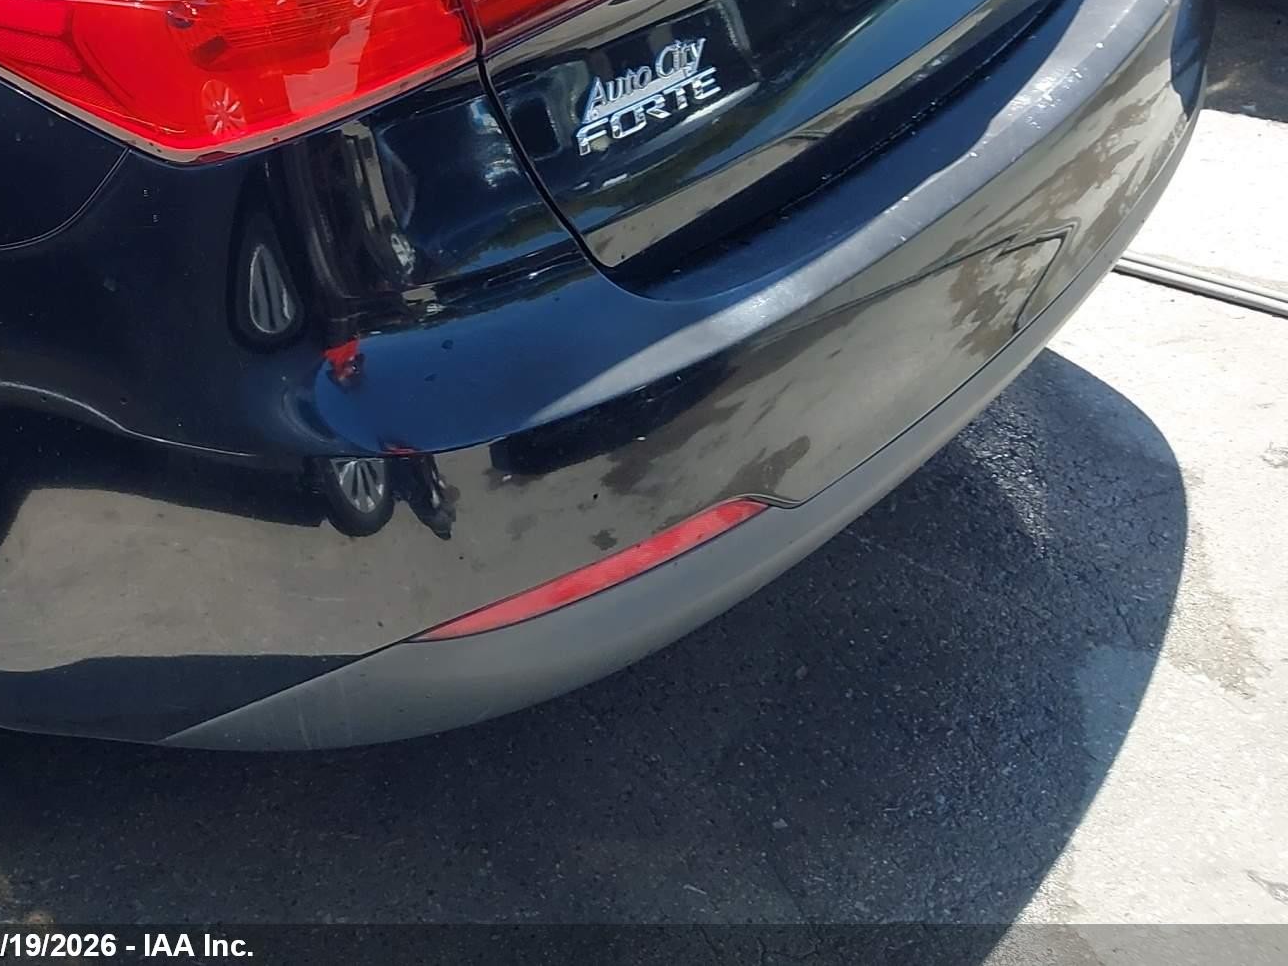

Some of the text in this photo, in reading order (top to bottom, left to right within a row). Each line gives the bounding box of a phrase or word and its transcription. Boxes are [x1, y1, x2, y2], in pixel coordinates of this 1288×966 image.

[576, 66, 721, 156] FORTE
[584, 37, 707, 120] Auto City
